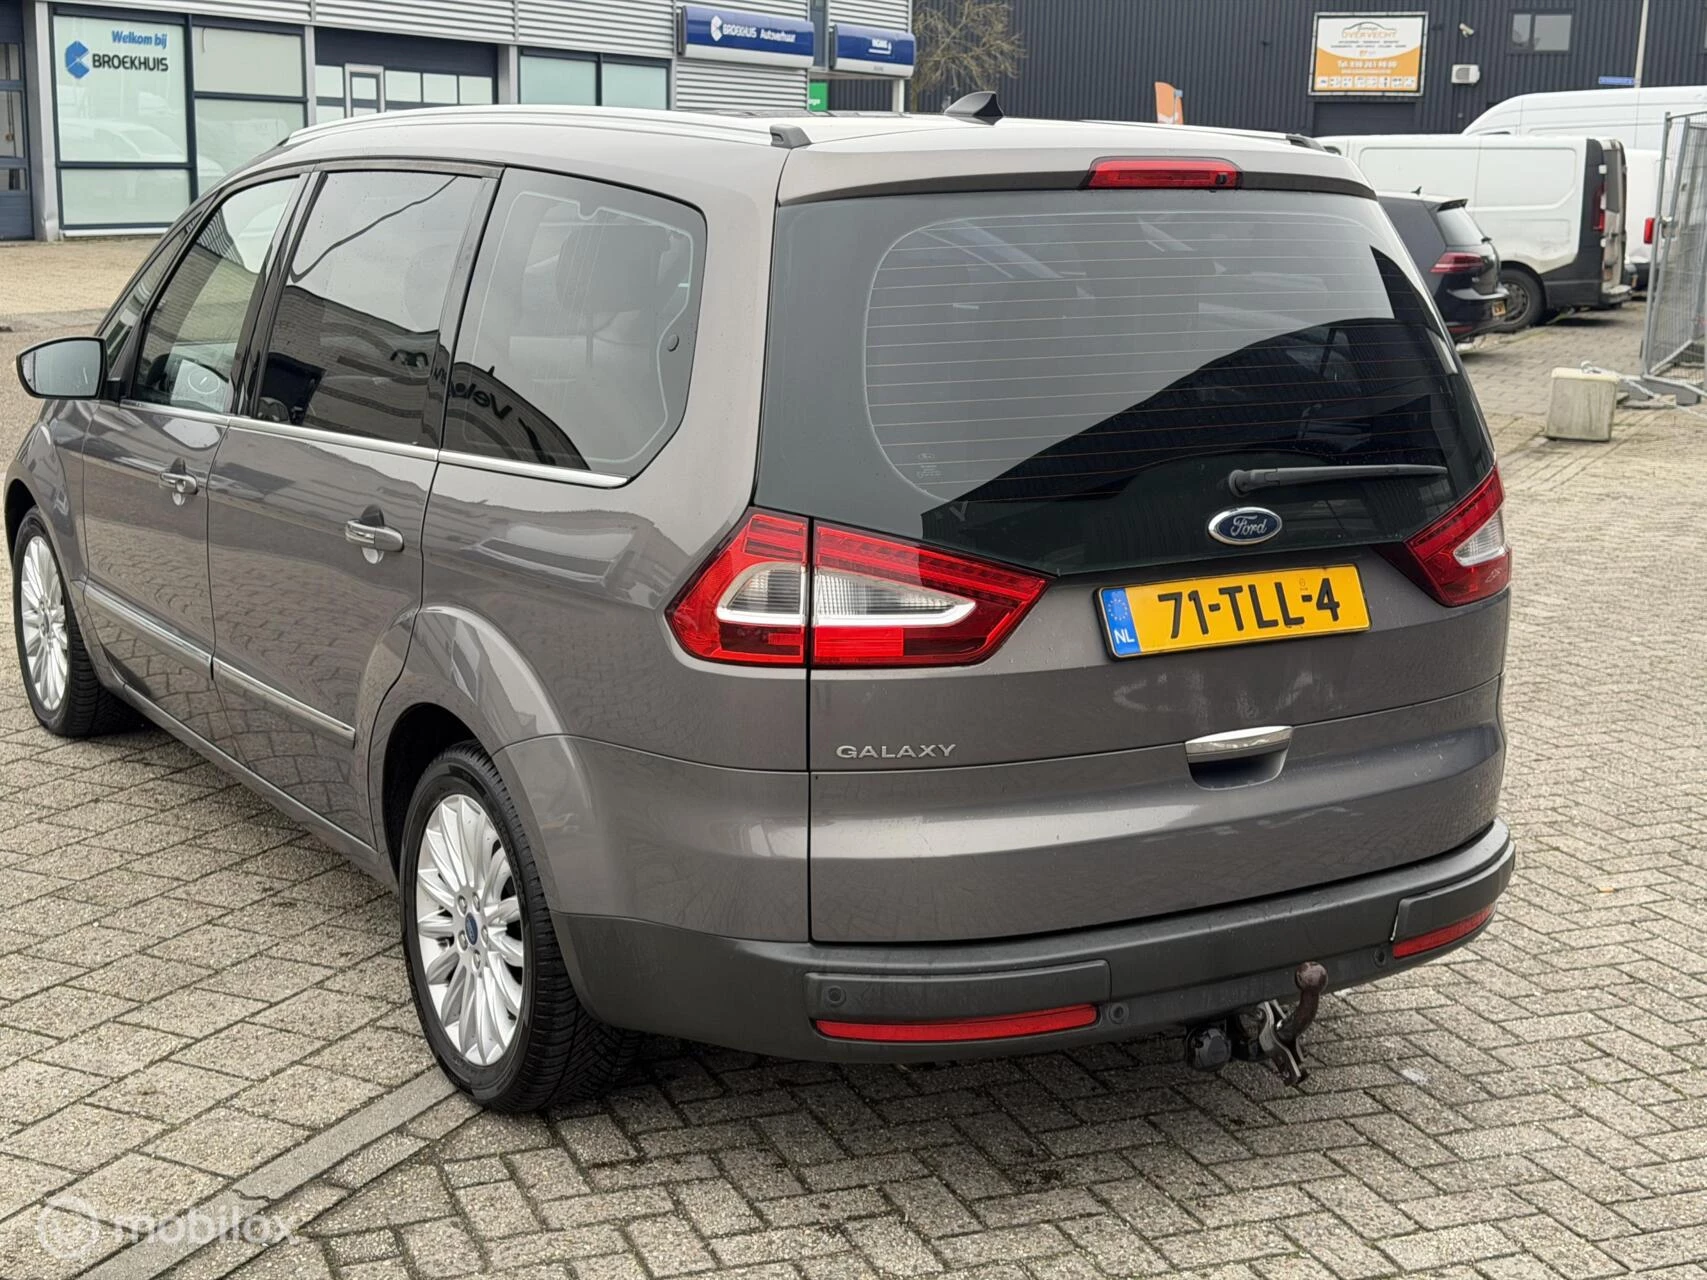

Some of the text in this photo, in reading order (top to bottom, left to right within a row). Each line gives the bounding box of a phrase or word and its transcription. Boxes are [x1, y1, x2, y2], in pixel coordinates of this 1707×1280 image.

[111, 30, 167, 49] Welkom bij
[92, 53, 169, 72] BROEKHUIS
[1230, 514, 1268, 537] Ford
[1157, 577, 1341, 640] 71-TLL-4
[1113, 630, 1135, 644] NL
[836, 744, 956, 759] GALAXY
